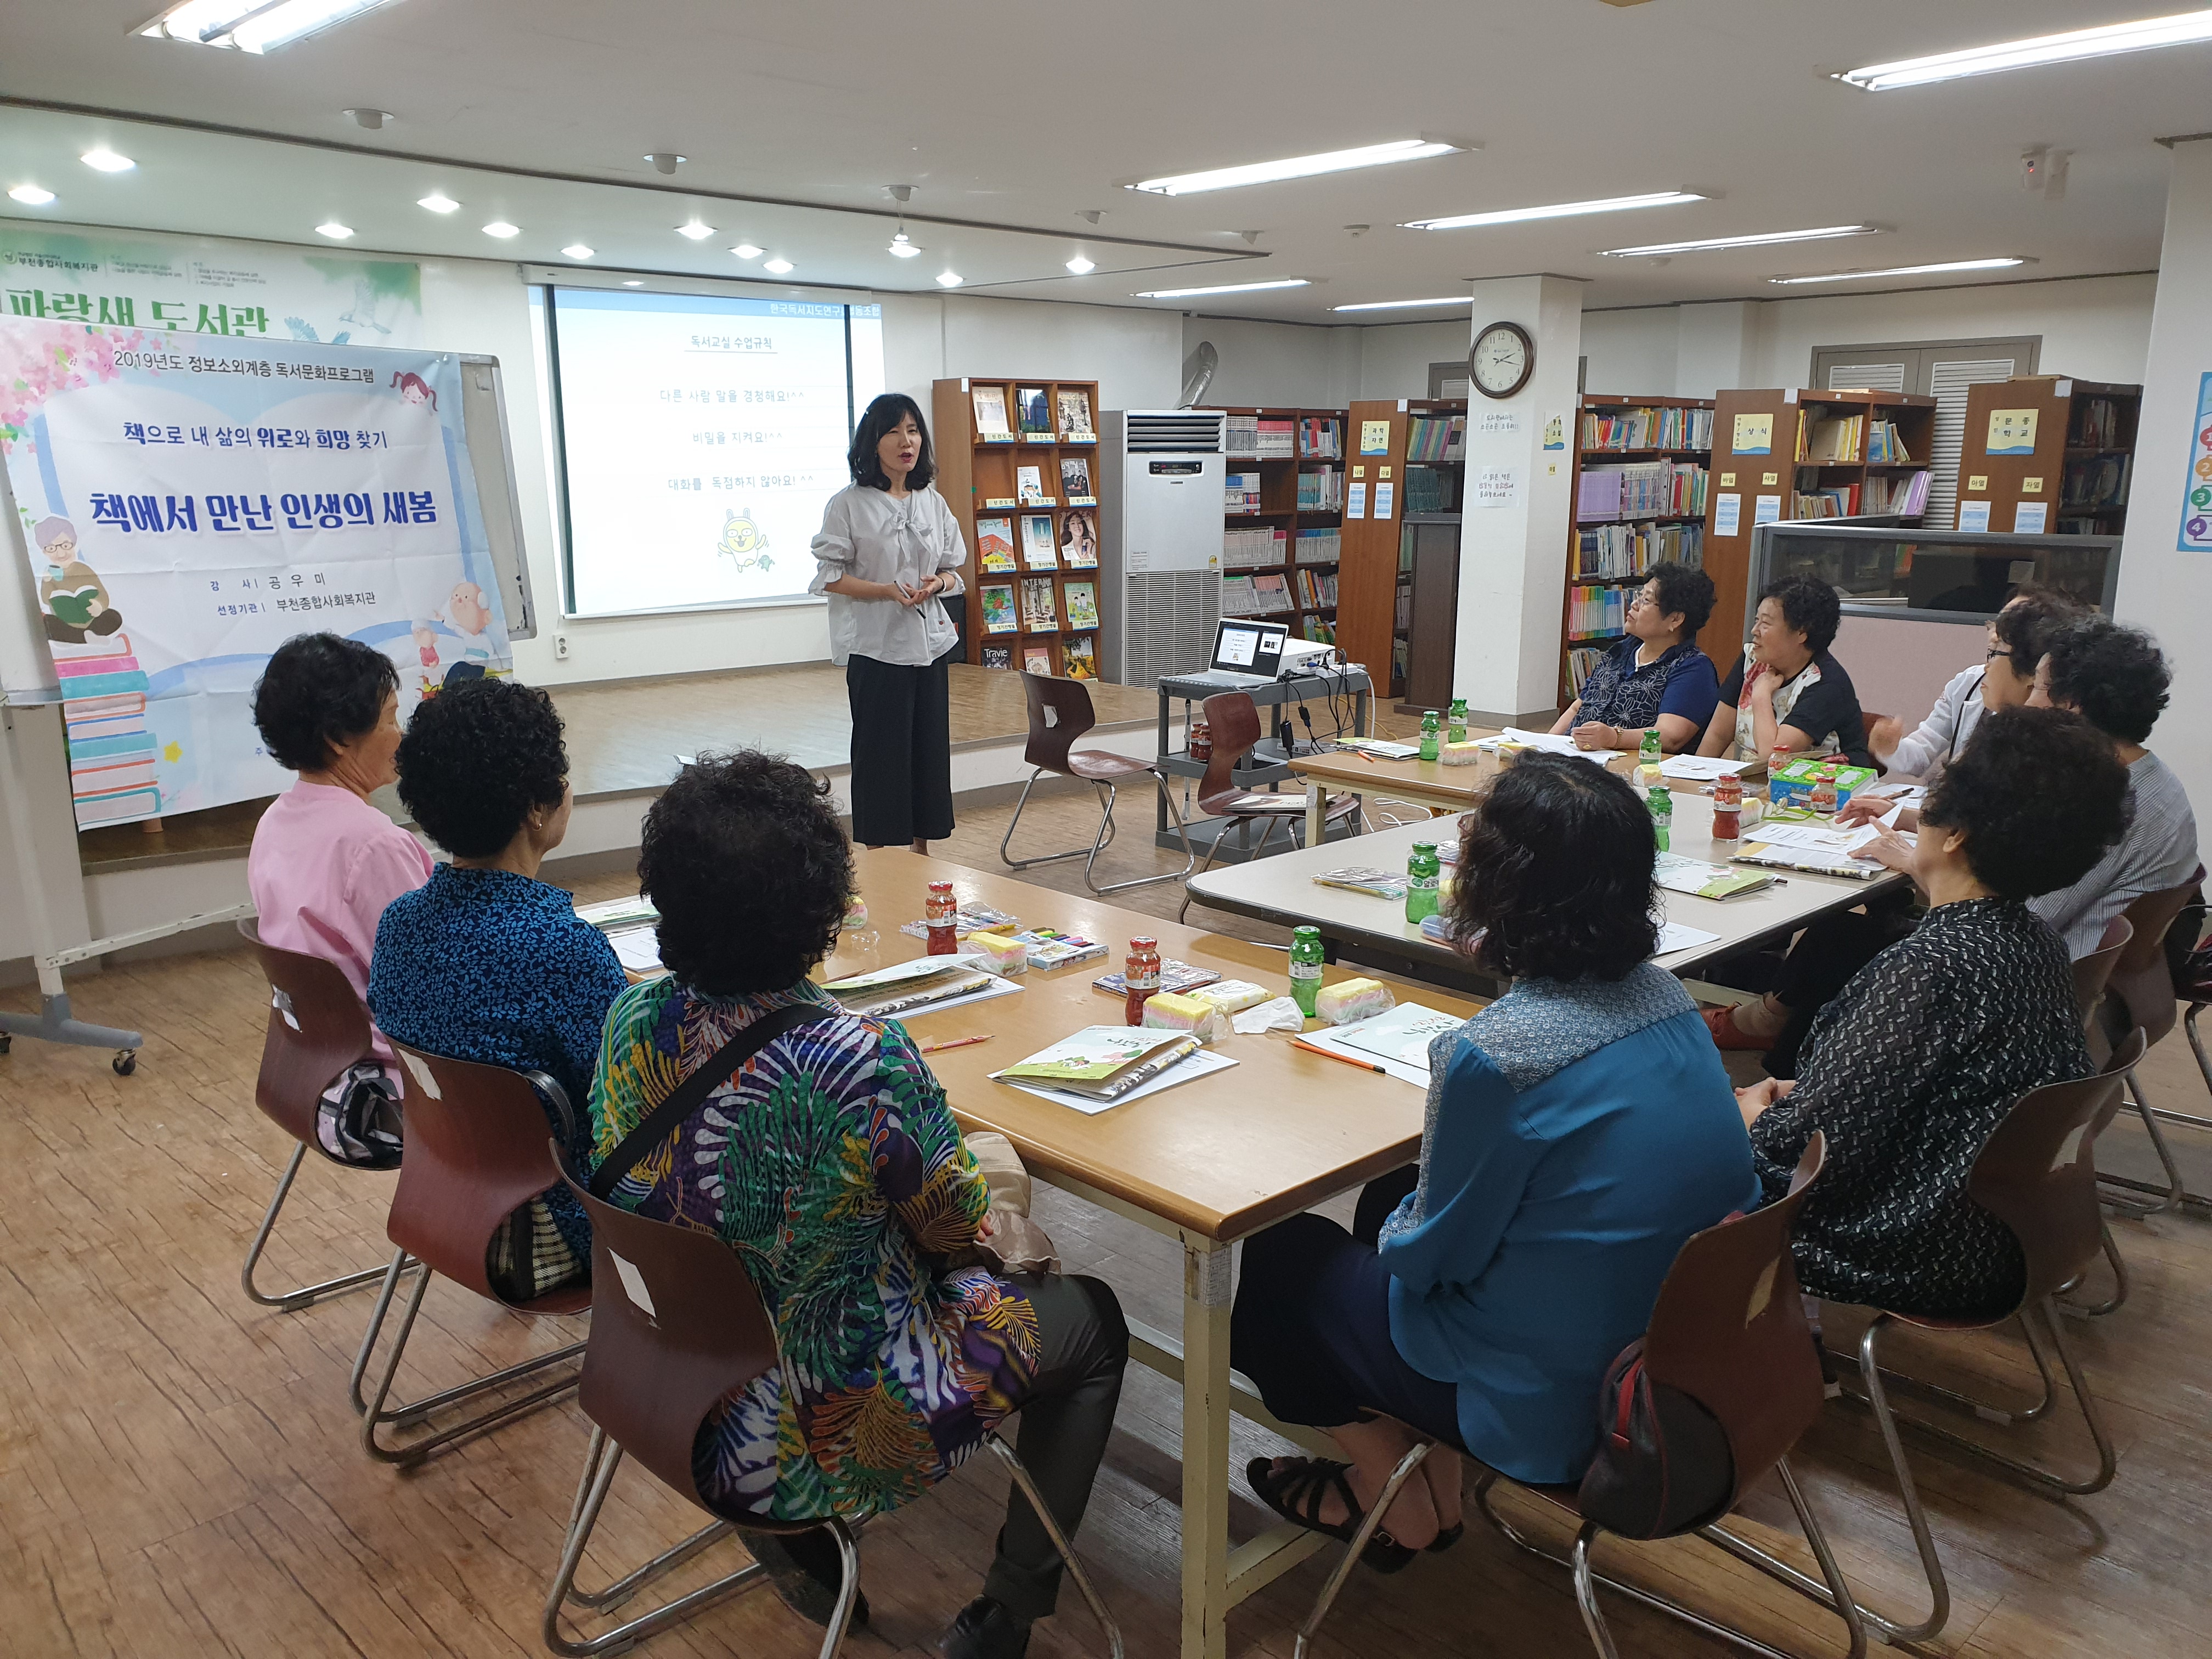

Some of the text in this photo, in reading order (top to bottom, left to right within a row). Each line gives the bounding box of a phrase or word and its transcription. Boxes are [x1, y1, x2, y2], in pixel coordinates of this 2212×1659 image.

[691, 335, 772, 349] 독서교실 수업규칙
[114, 351, 375, 383] 2019년도 정보소외계층 독서문화프로그램
[660, 390, 682, 402] 다른
[689, 390, 710, 403] 사람
[716, 390, 737, 403] 말을
[123, 421, 387, 449] 책으로 내 삶의 위로와 희망 찾기
[693, 432, 725, 444] 비밀을
[2203, 462, 2210, 472] 2
[712, 476, 755, 489] 독점하지
[2196, 493, 2205, 502] 3
[89, 490, 437, 532] 책에서 만난 인생의 새봄
[2192, 522, 2201, 532] 4
[217, 591, 376, 616] 선정기관 부천종합사회복지관
[984, 648, 1008, 658] Travie
